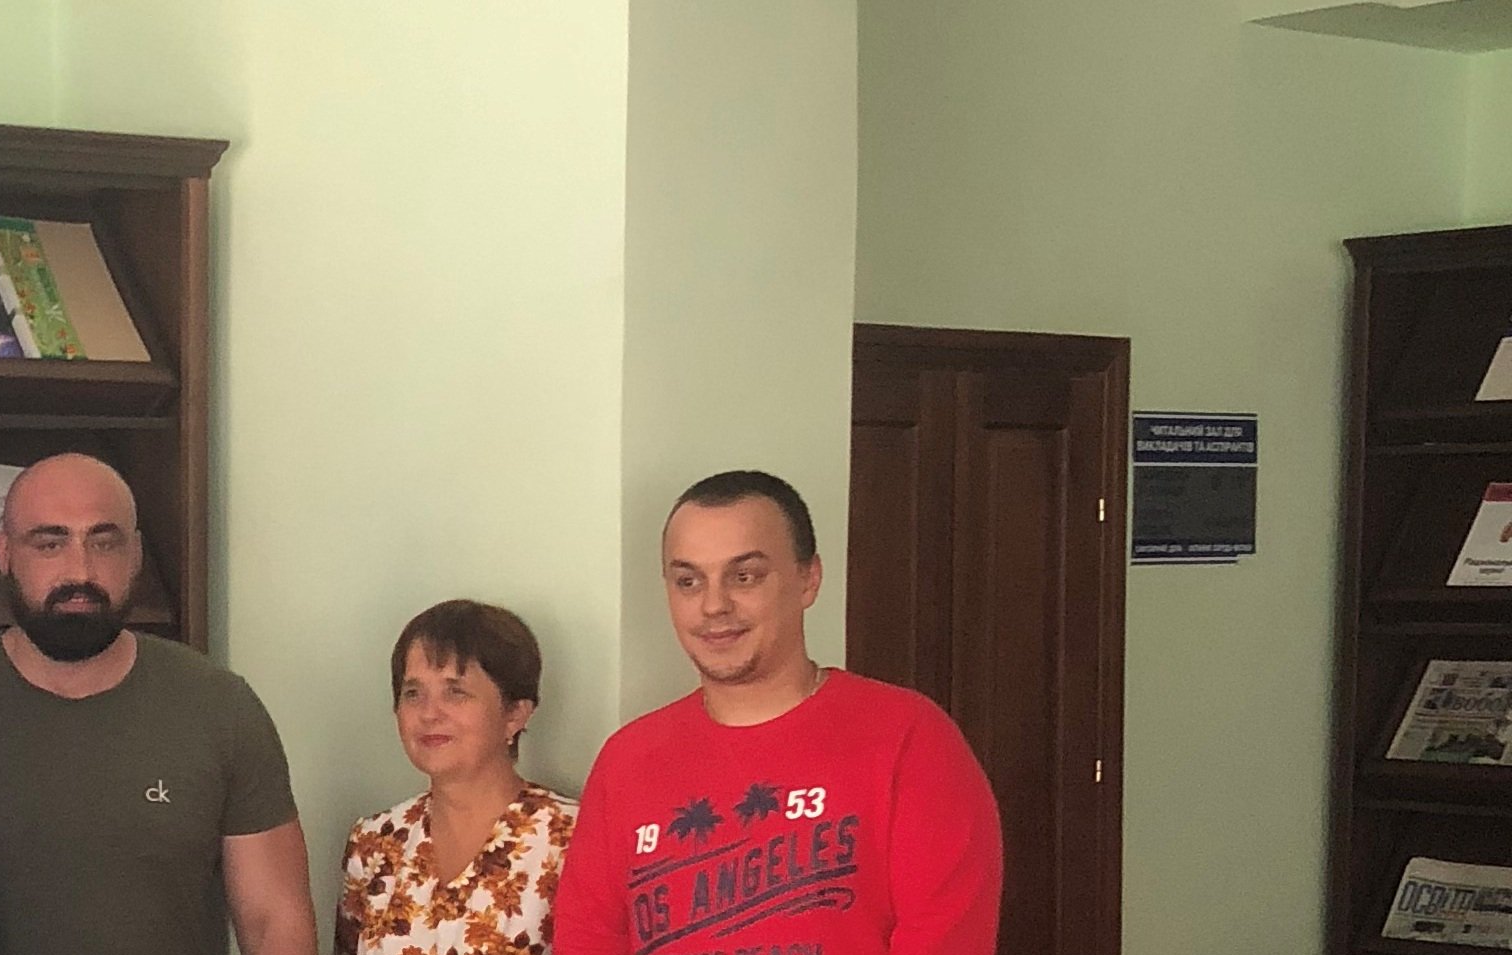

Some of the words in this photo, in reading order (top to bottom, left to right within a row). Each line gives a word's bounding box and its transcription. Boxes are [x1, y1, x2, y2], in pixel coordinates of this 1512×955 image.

[635, 823, 660, 855] 19
[785, 787, 826, 820] 53
[633, 884, 670, 942] OS
[690, 815, 859, 918] ANGELES
